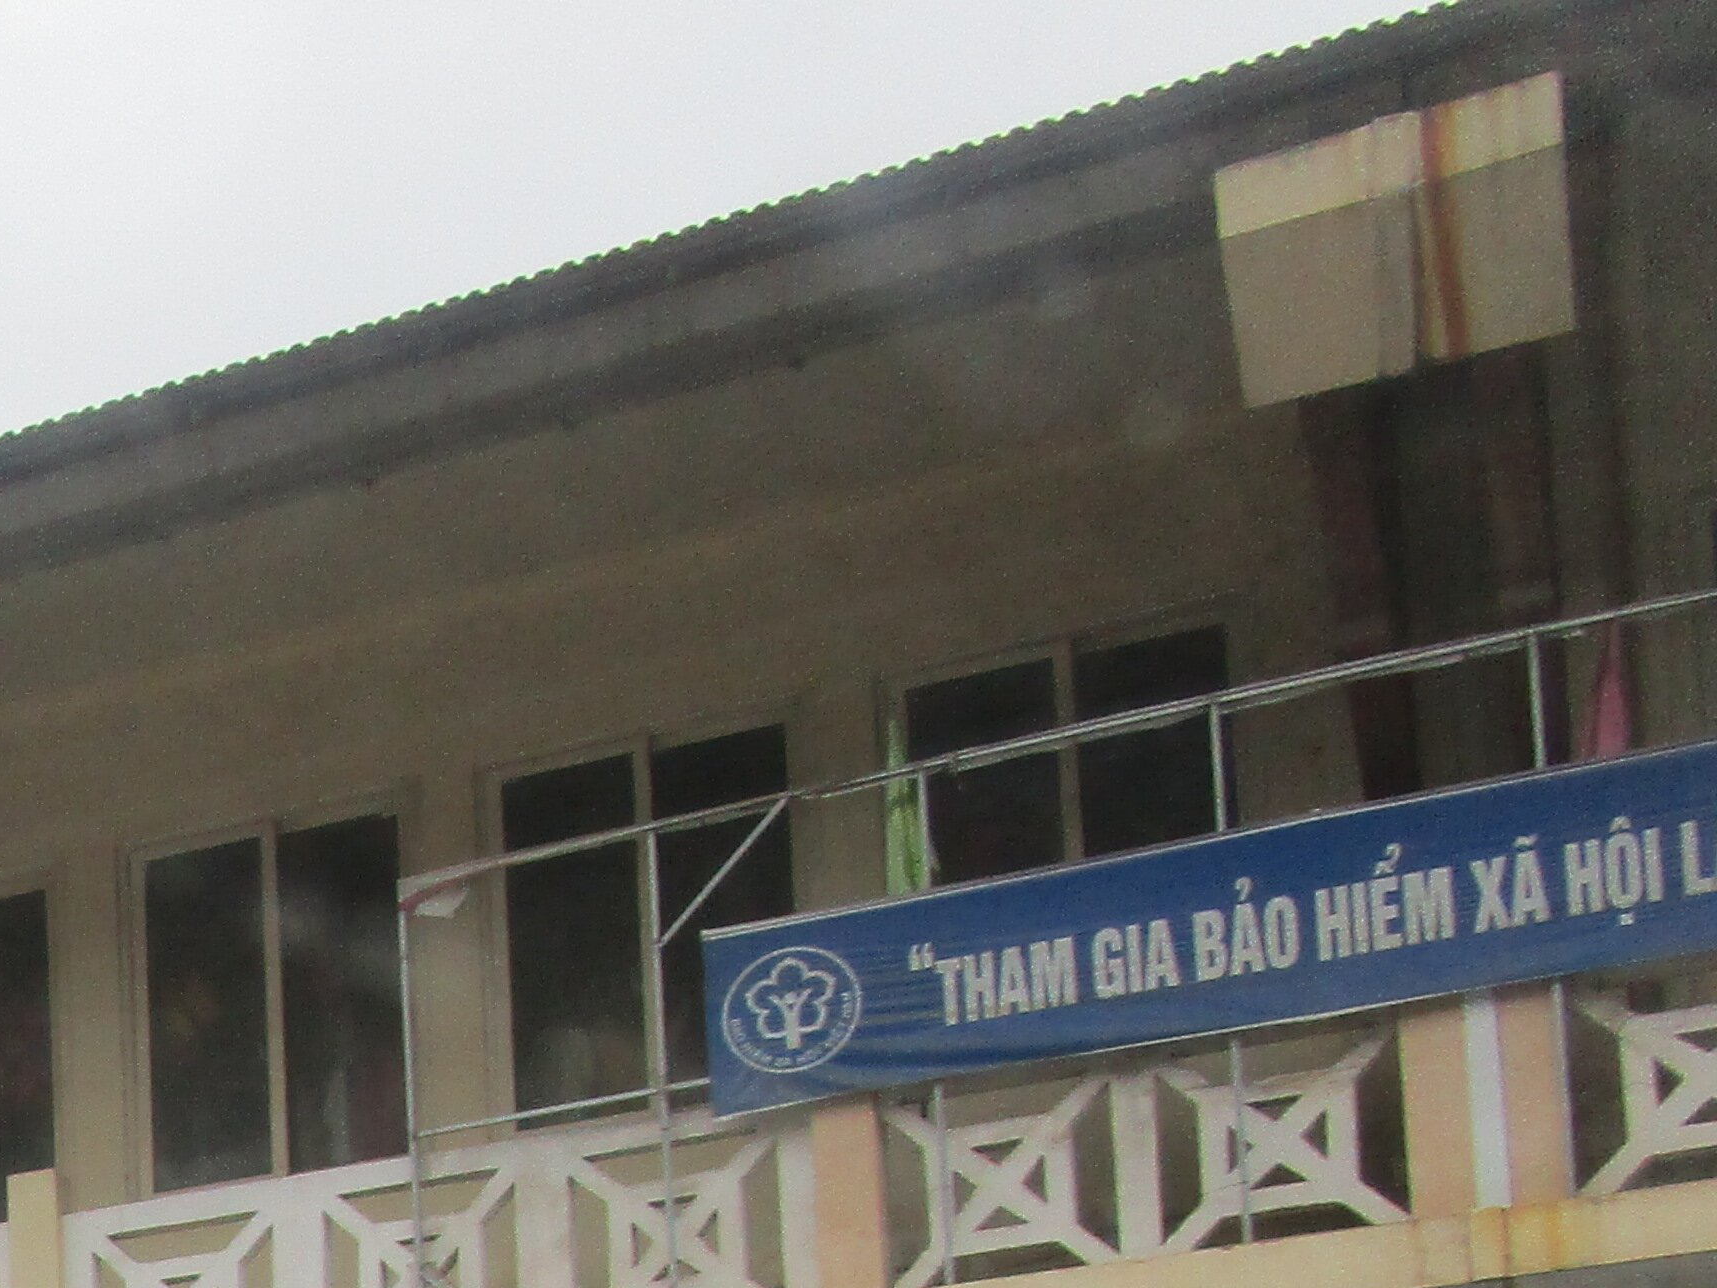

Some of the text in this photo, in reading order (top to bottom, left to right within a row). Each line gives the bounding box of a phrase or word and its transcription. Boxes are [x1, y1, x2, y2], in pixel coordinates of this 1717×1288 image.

[1092, 919, 1182, 999] GIA
[1192, 876, 1302, 981] BẢO
[1314, 843, 1457, 962] HIỂM
[1469, 834, 1552, 934] XÃ
[1564, 816, 1664, 926] HỘI
